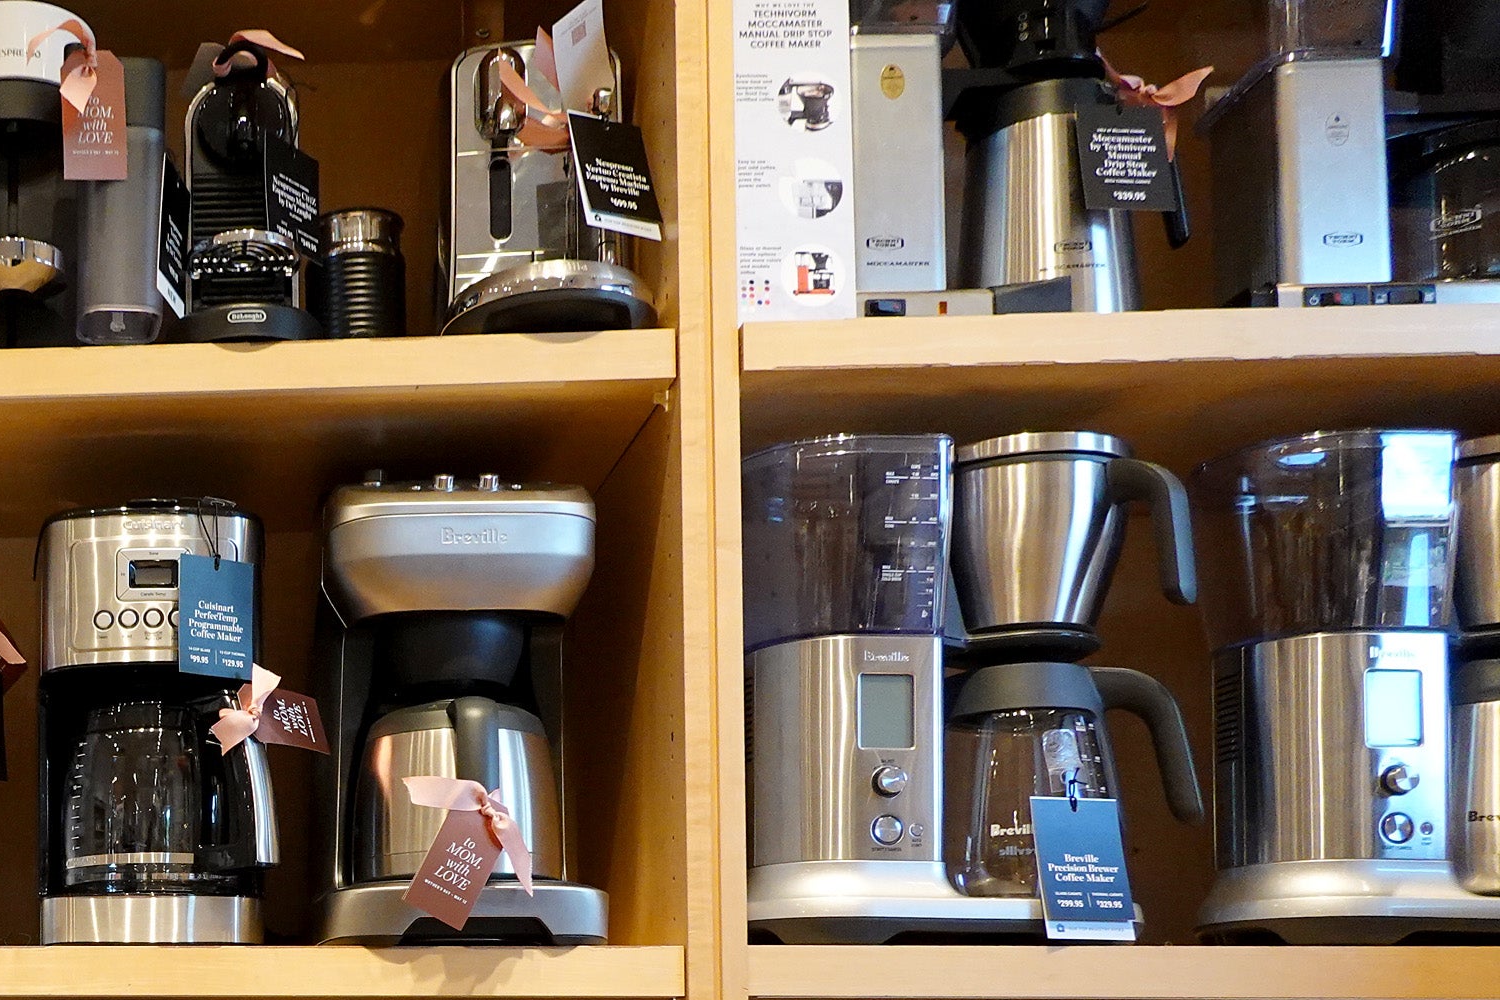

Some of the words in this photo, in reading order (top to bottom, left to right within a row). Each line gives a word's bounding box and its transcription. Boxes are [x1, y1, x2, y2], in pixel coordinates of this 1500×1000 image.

[753, 10, 817, 18] TECHNIVORM
[747, 20, 823, 28] MOCCAMASTER
[783, 30, 805, 38] DRIP
[807, 30, 832, 38] STOP
[788, 40, 821, 48] MAKER
[83, 119, 107, 131] with
[78, 131, 113, 144] LOVE
[1092, 133, 1153, 143] Moccamaster
[1090, 142, 1101, 152] by
[1102, 143, 1157, 152] Technivorm
[1107, 151, 1142, 160] Manual
[1104, 159, 1125, 169] Drip
[1126, 160, 1148, 169] Stop
[1095, 167, 1126, 177] Coffee
[1127, 168, 1157, 177] Maker
[122, 519, 185, 532] Cuisinart
[440, 526, 508, 545] Breville
[198, 600, 234, 613] Cuisinart
[194, 608, 238, 625] PerfecTemp
[188, 618, 244, 634] Programmable
[190, 628, 216, 640] Coffee
[217, 632, 242, 643] Maker
[190, 654, 209, 664] $99.95
[222, 658, 244, 668] $129.95
[990, 824, 1033, 838] Brevil
[463, 837, 476, 849] to
[446, 842, 483, 870] MOM,
[1064, 853, 1099, 863] Breville
[446, 858, 470, 877] with
[1047, 863, 1087, 873] Precision
[1088, 863, 1119, 873] Brewer
[434, 865, 471, 891] LOVE
[1055, 873, 1085, 882] Coffee
[1086, 873, 1115, 883] Maker
[1057, 899, 1084, 908] $299.95
